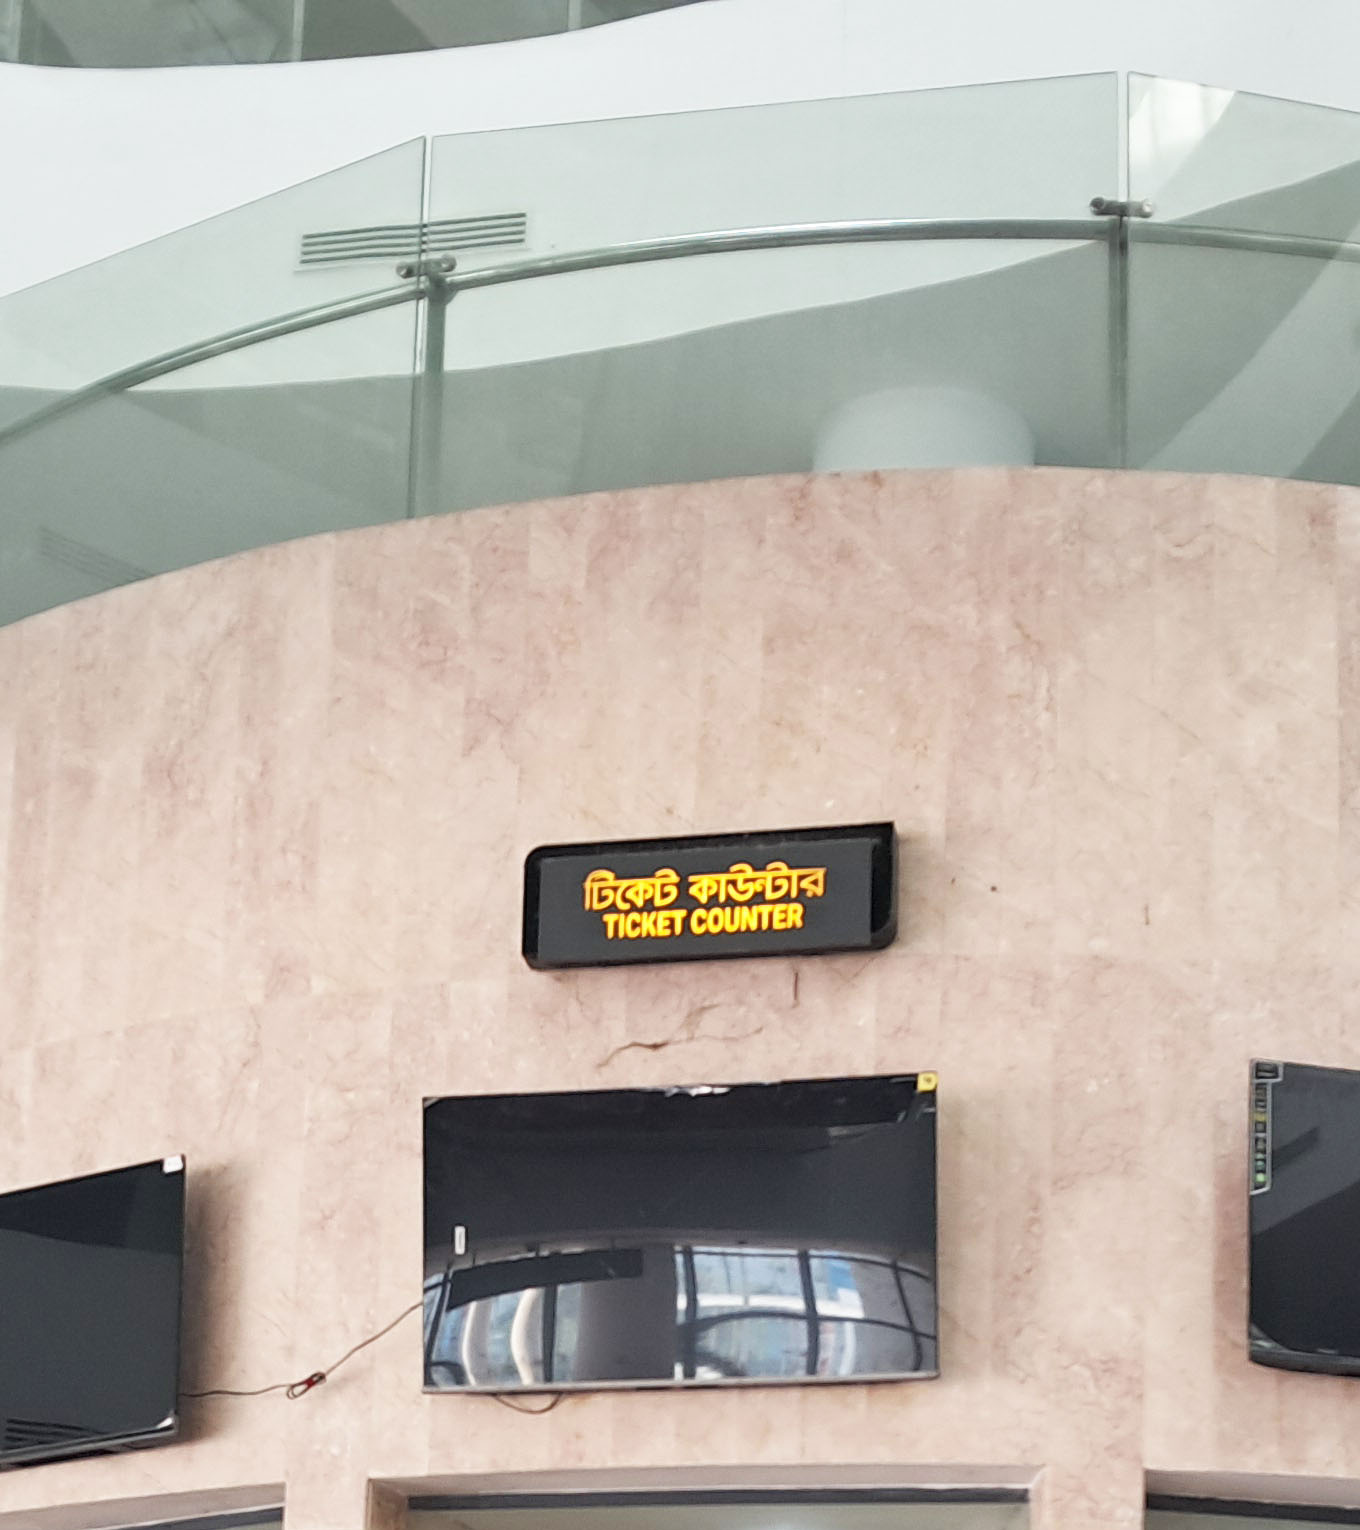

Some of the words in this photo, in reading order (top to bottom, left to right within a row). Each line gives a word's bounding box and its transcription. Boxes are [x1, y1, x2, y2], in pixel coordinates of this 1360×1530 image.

[583, 868, 681, 911] টিকেট
[688, 861, 827, 904] কাউন্টার
[602, 908, 687, 939] TICKET
[690, 902, 804, 934] COUNTER
